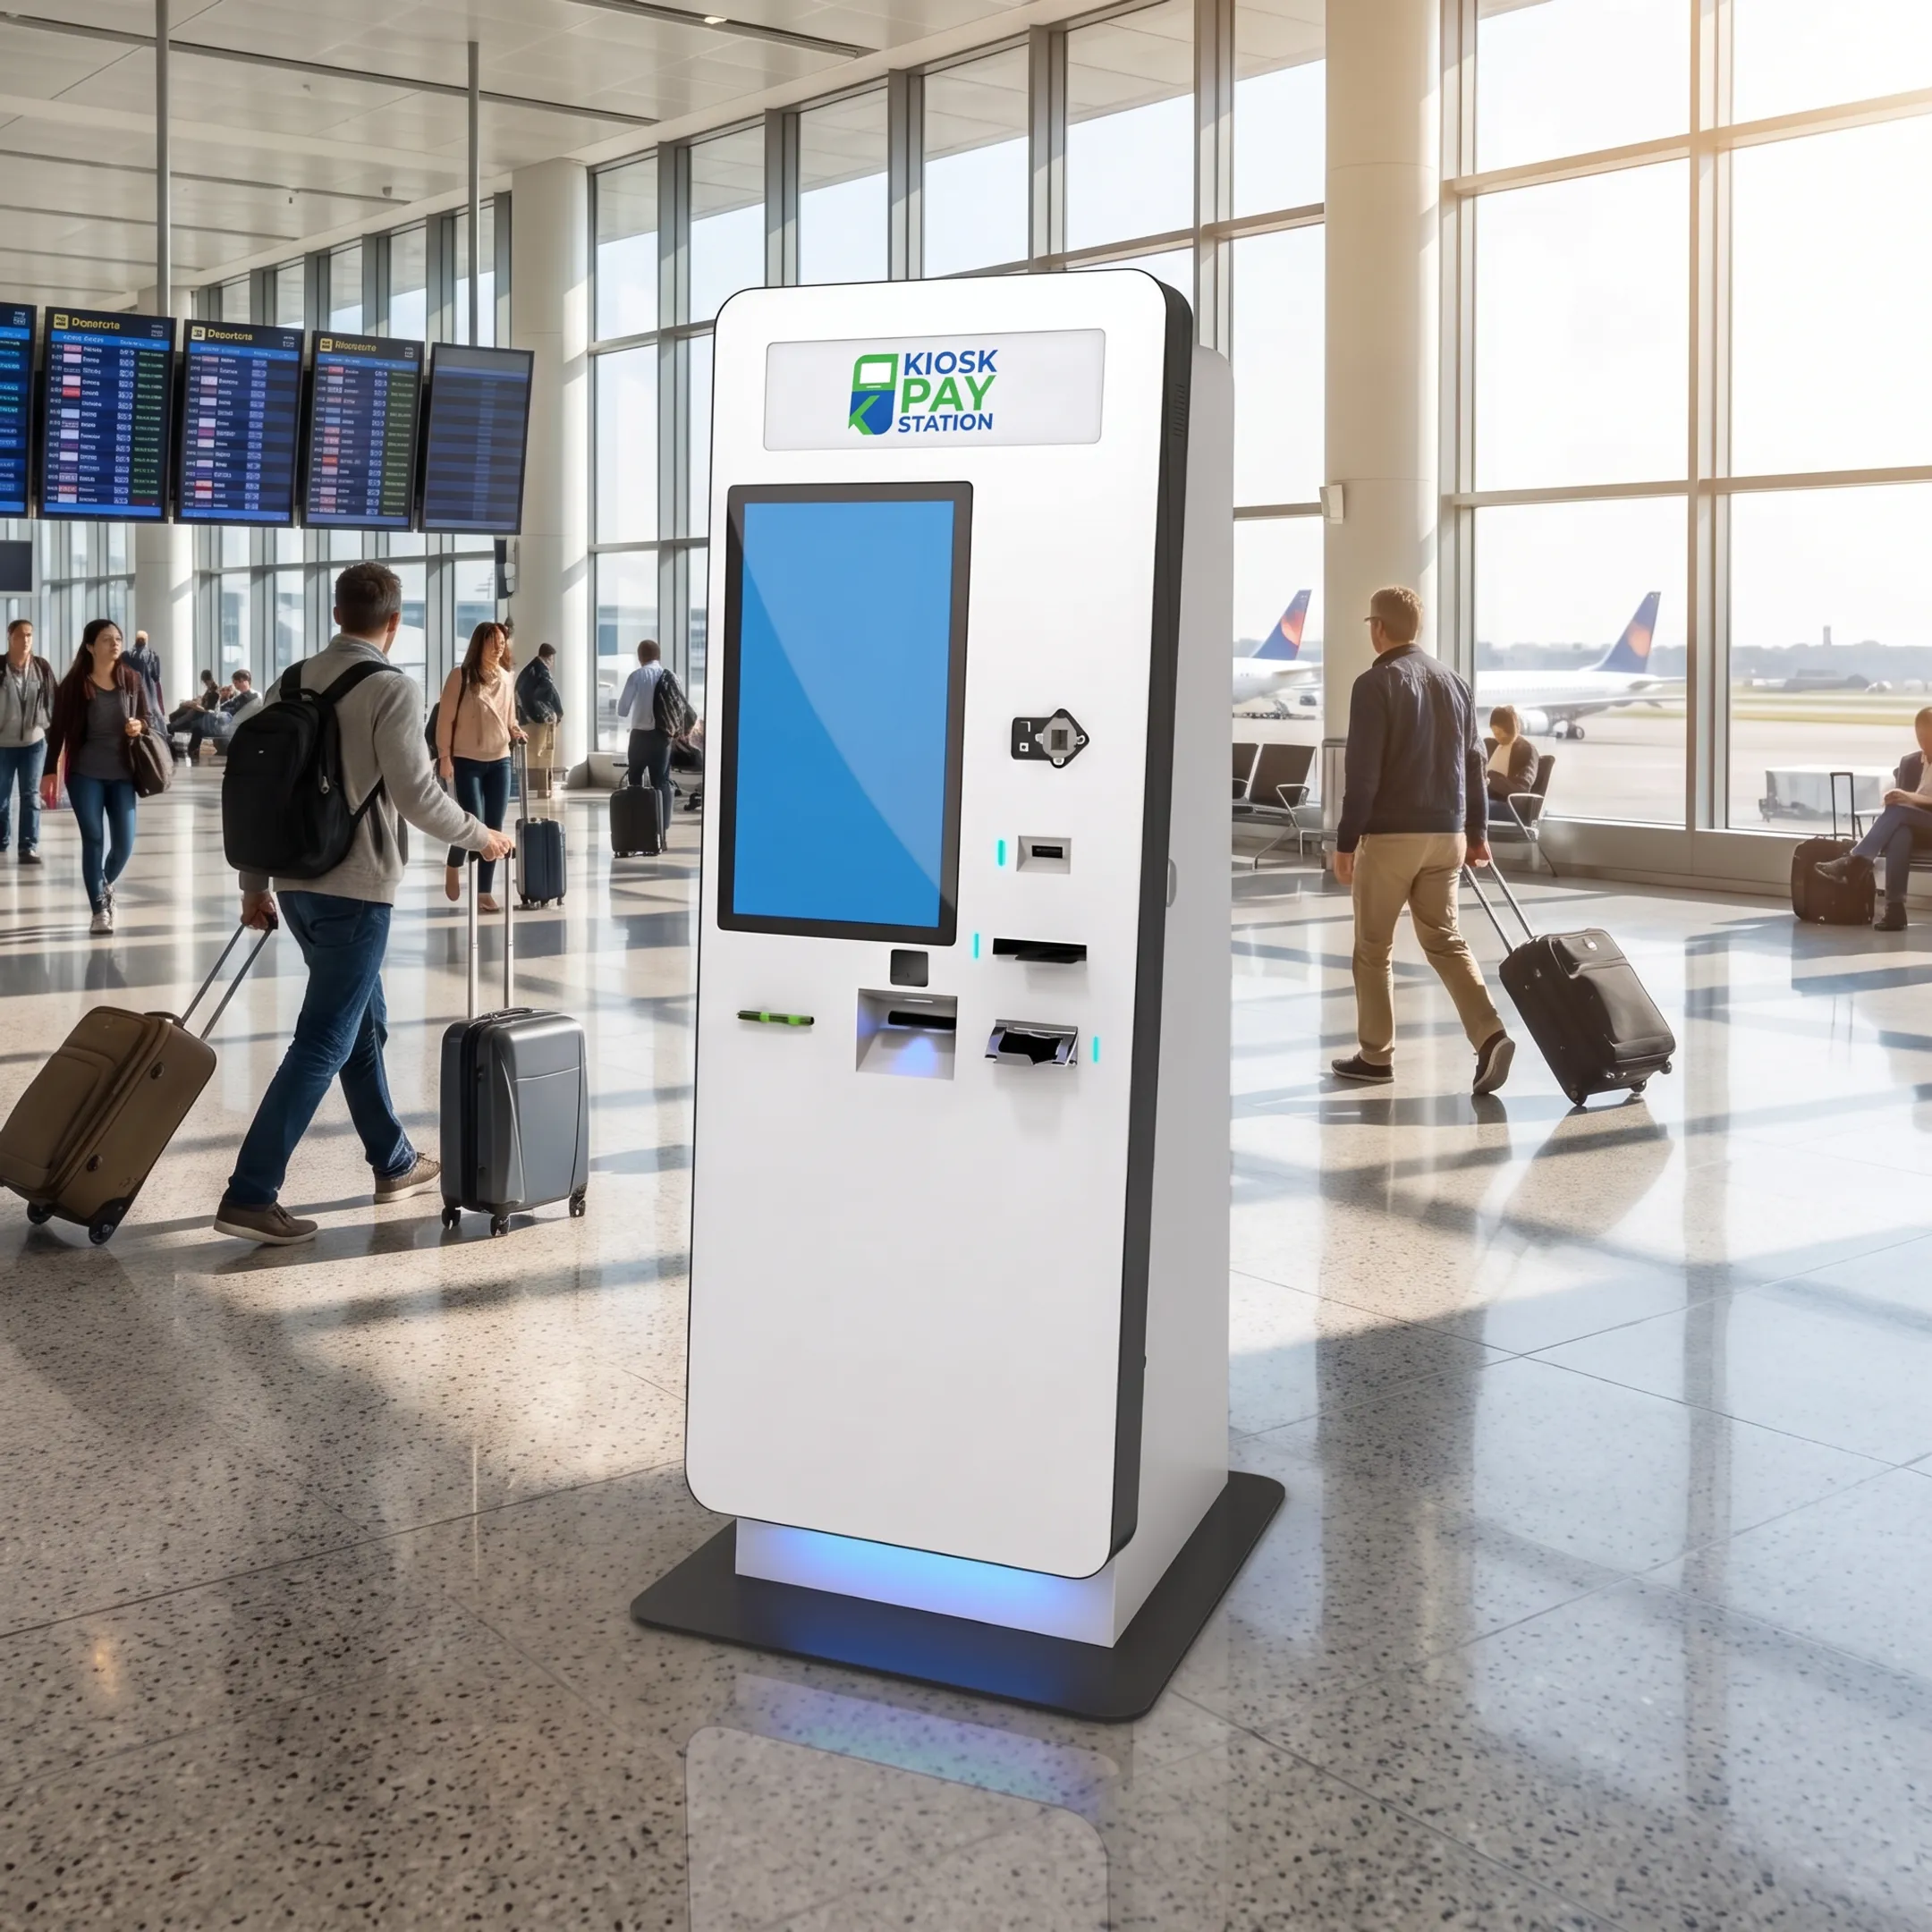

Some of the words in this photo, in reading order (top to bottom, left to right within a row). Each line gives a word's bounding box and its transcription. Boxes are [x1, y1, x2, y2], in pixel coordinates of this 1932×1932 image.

[903, 350, 998, 376] KIOSK
[901, 375, 996, 413] PAY
[897, 413, 994, 433] STATION
